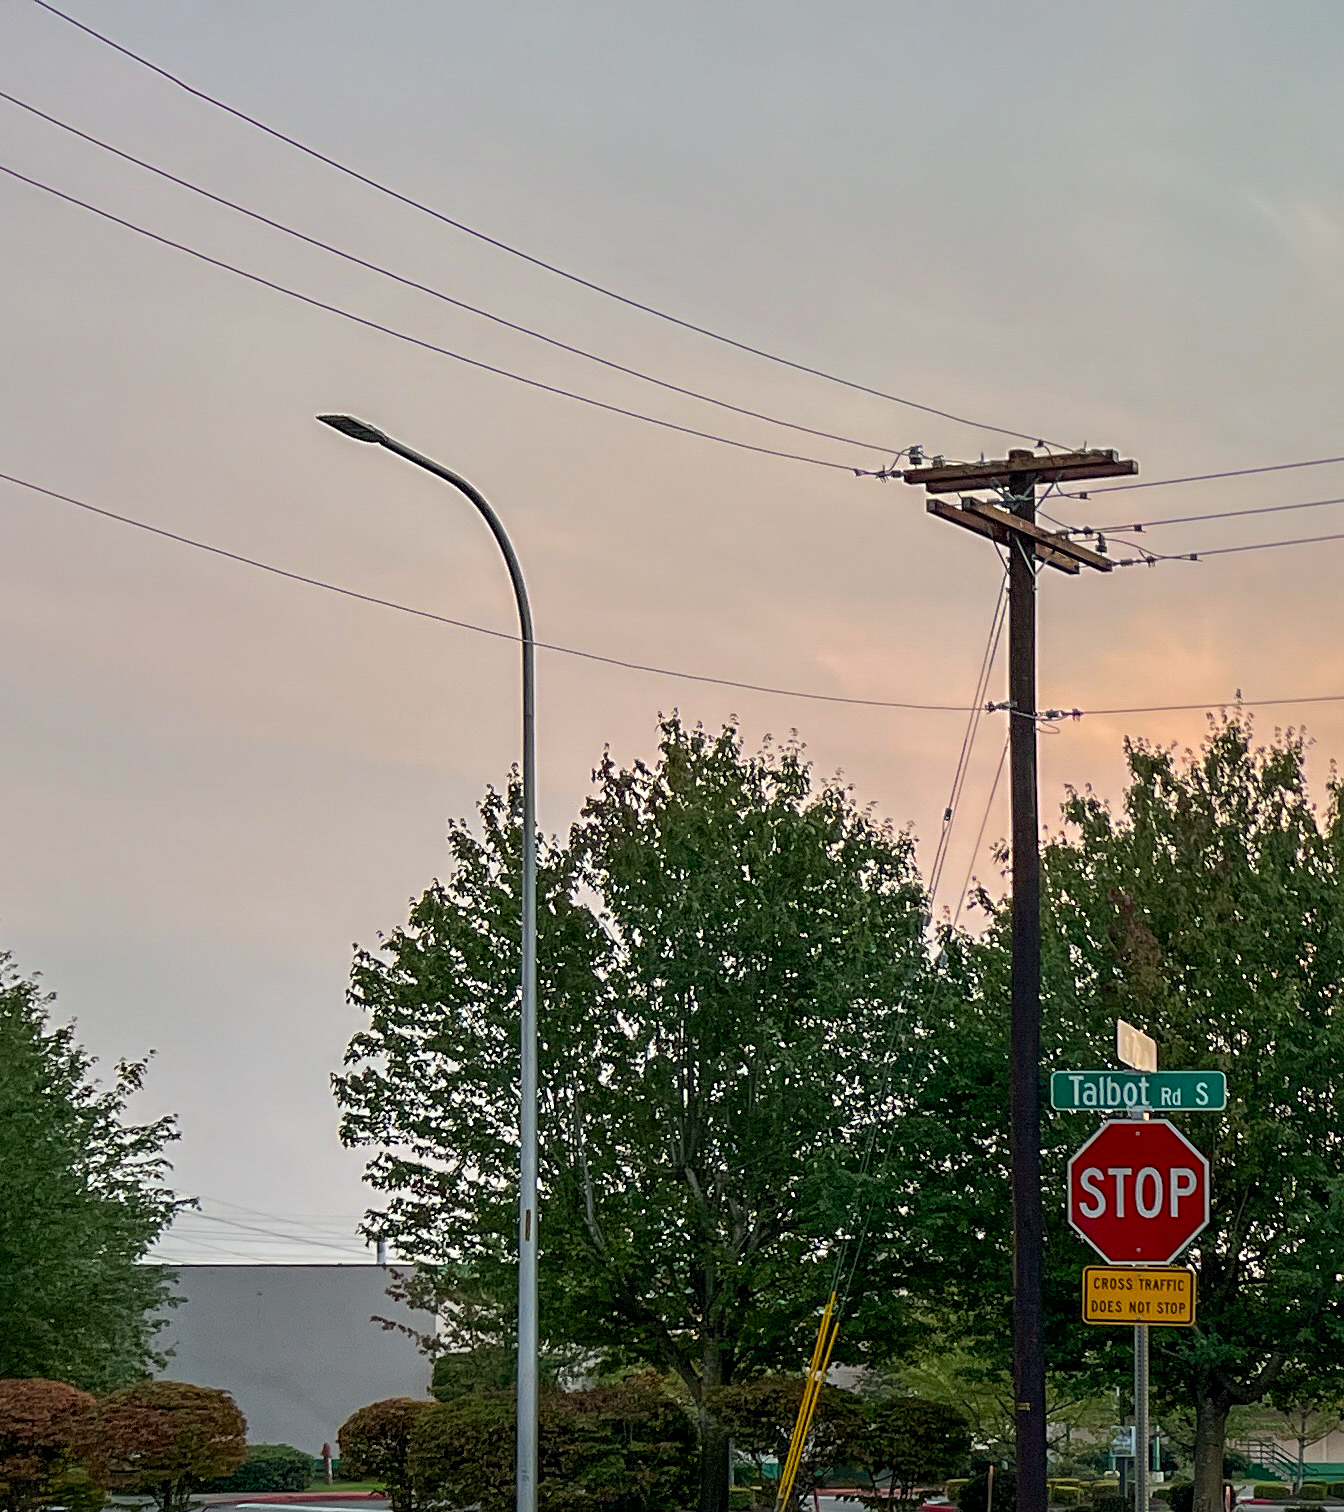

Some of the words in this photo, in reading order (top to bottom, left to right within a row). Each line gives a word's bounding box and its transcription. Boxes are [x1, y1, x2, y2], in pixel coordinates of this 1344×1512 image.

[1068, 1075, 1150, 1107] Talbot
[1160, 1087, 1182, 1107] Rd
[1195, 1082, 1210, 1107] S
[1078, 1166, 1198, 1219] STOP
[1092, 1277, 1133, 1292] CROSS
[1138, 1277, 1186, 1293] TRAFFIC
[1090, 1300, 1123, 1315] DOES
[1128, 1301, 1152, 1315] NOT
[1156, 1301, 1187, 1316] STOP
